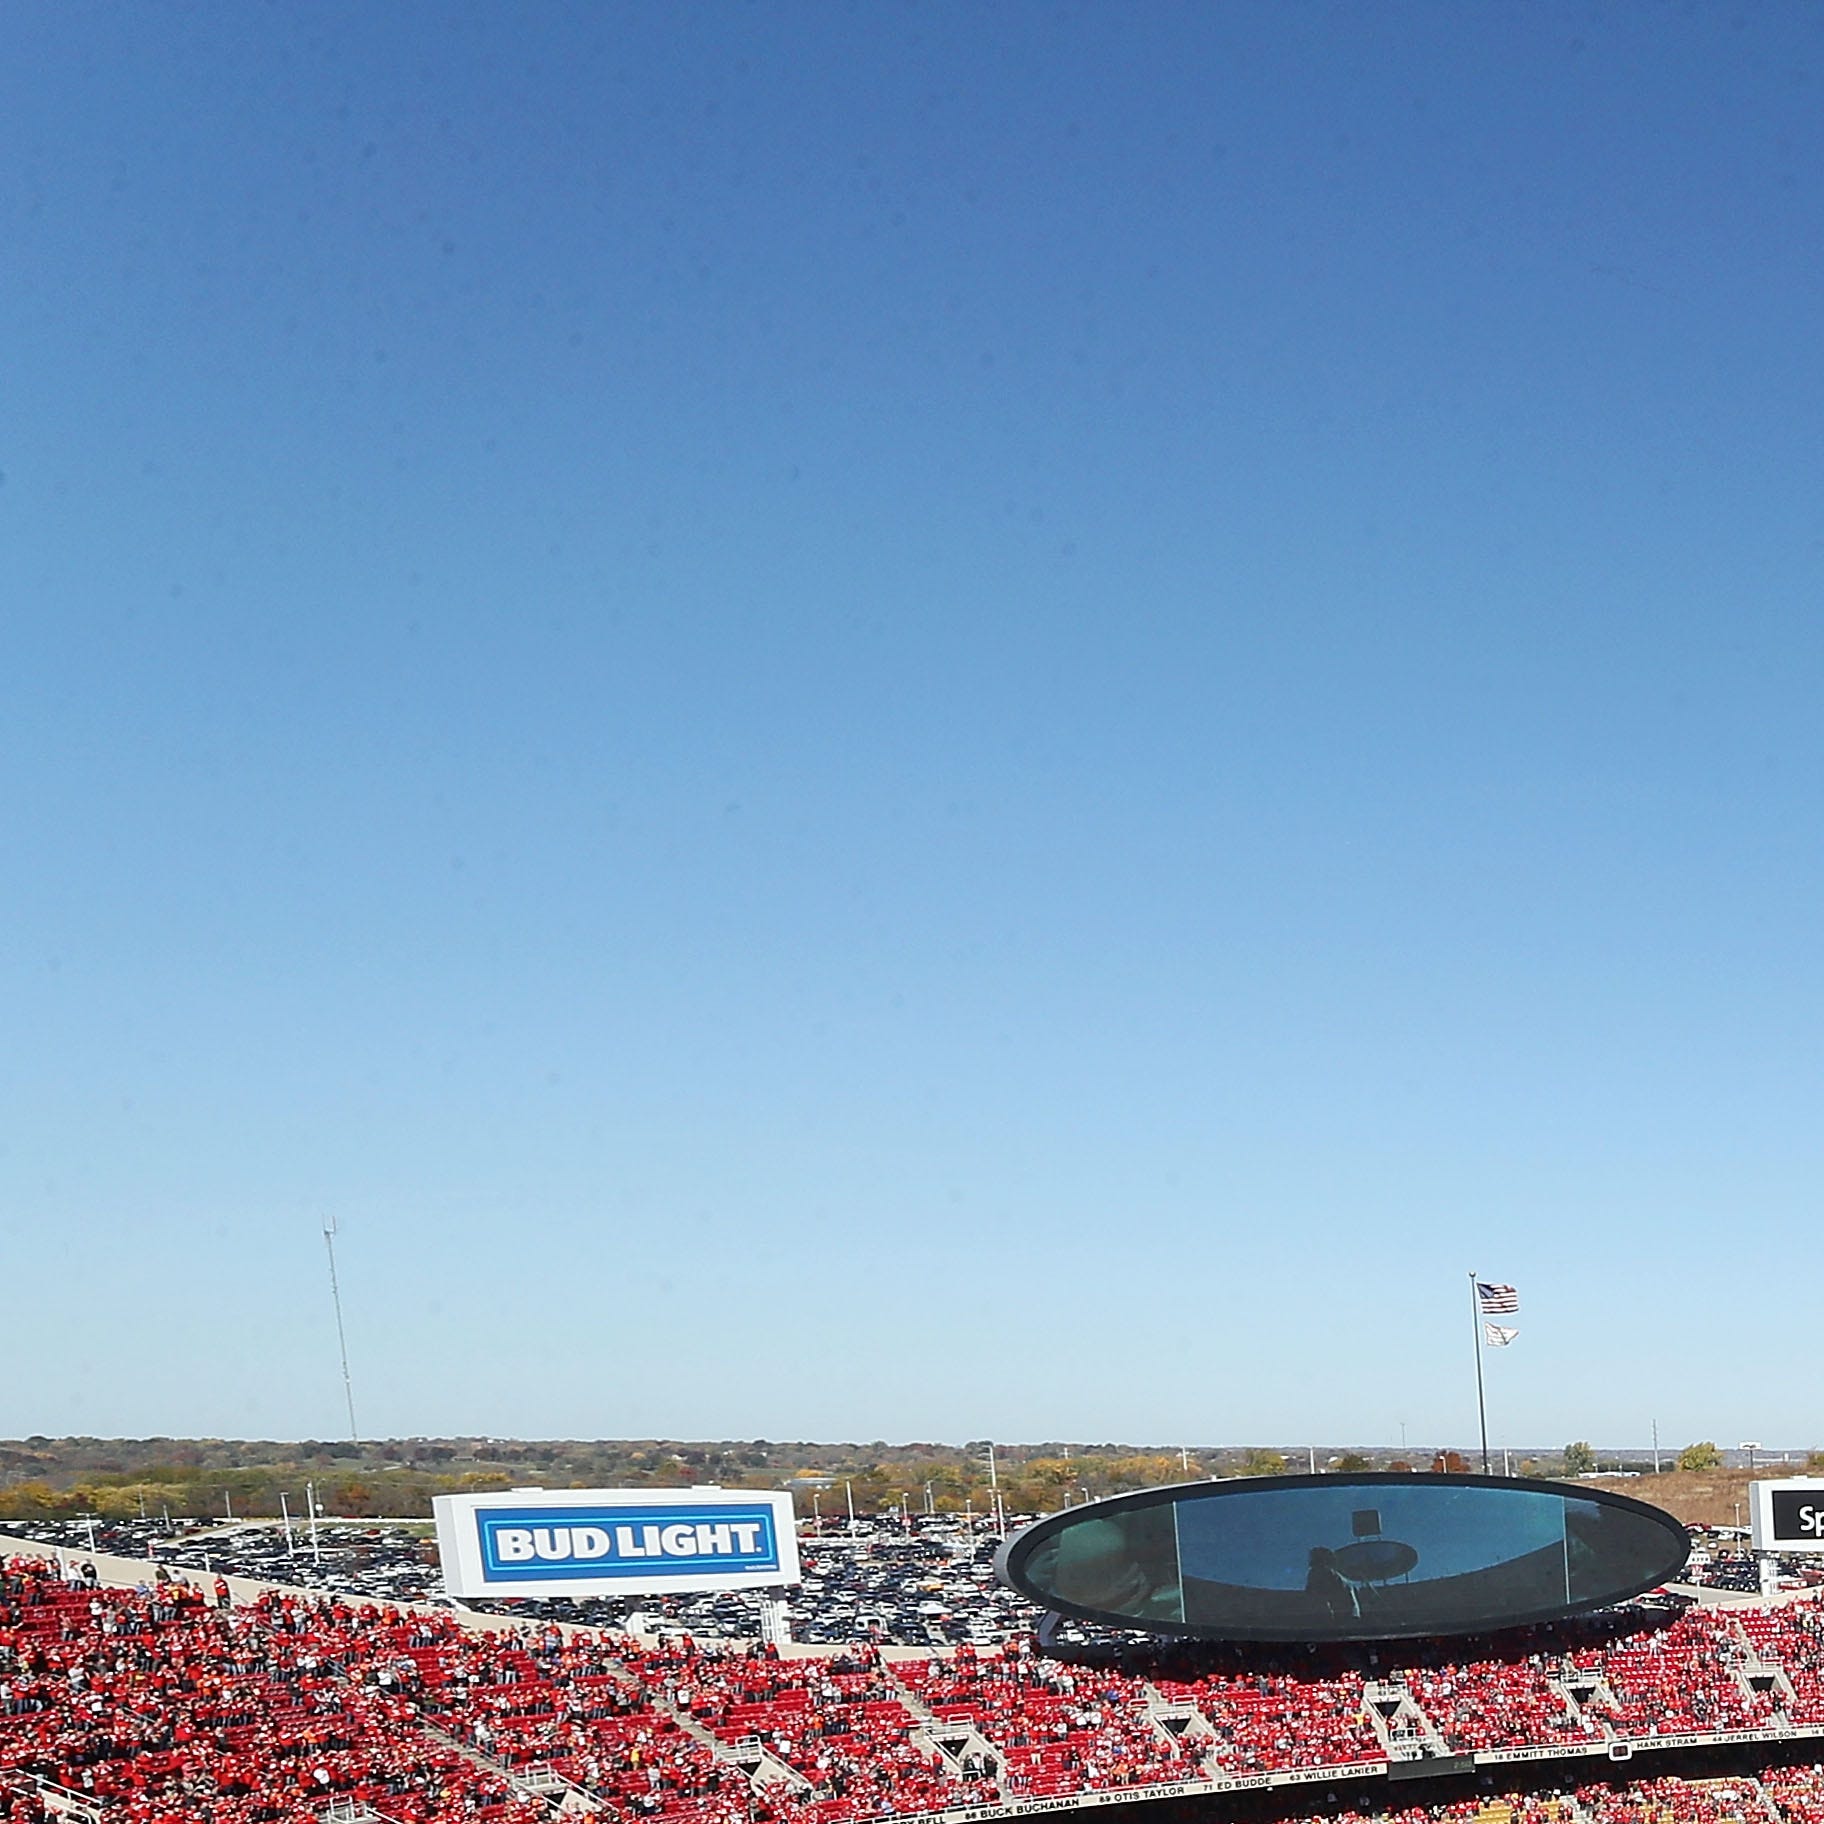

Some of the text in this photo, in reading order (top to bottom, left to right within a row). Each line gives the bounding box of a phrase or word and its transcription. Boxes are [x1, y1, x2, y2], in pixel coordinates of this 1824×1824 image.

[496, 1526, 610, 1561] BUD
[1724, 1730, 1797, 1741] JERREL WILSON
[1637, 1740, 1662, 1749] HANK
[1506, 1746, 1588, 1760] EMMITT THOMAS
[1304, 1769, 1337, 1779] WILLIE
[1341, 1765, 1378, 1777] LANIER
[1217, 1781, 1232, 1790] ED
[1235, 1777, 1272, 1788] BUDDE
[1114, 1786, 1185, 1801] OTIS TAYLOR
[980, 1798, 1080, 1818] BUCK BUCHANAN
